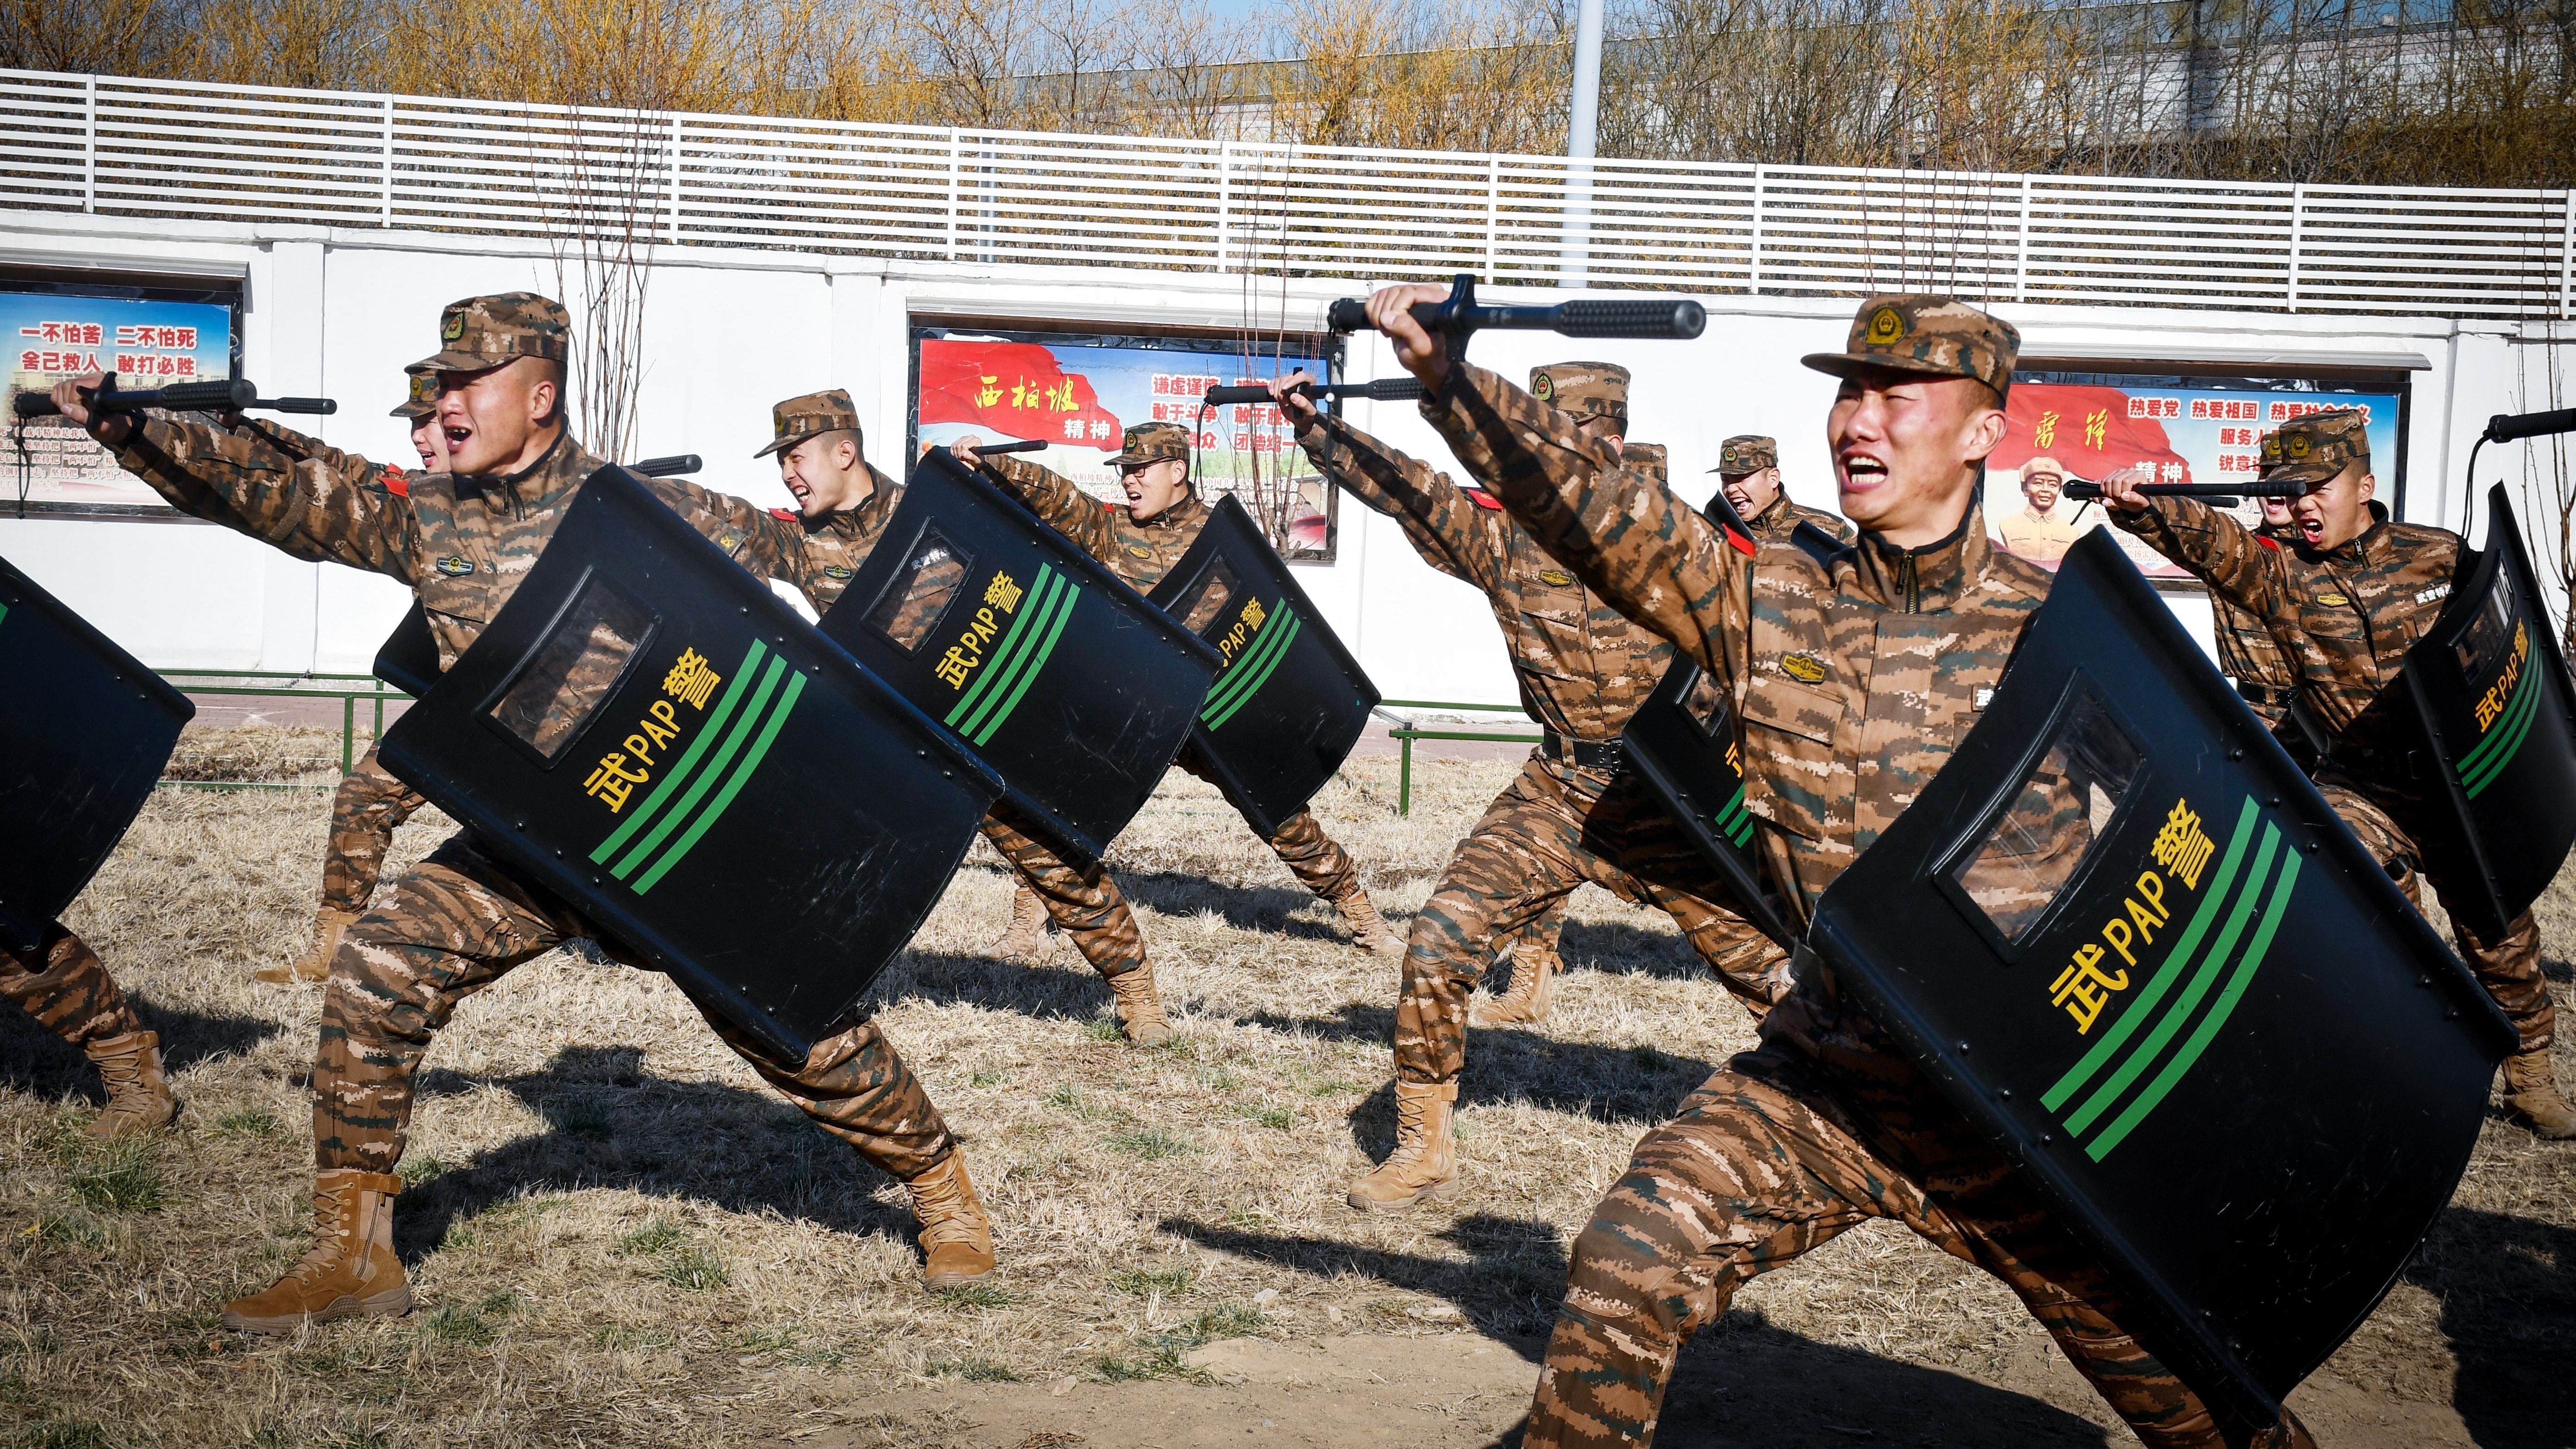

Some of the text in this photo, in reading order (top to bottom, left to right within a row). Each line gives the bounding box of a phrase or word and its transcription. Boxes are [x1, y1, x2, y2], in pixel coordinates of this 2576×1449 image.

[22, 323, 194, 347] 一不怕苦 二不怕死
[22, 351, 194, 375] 舍己救人 敢打必胜
[974, 375, 1080, 414] 西柏坡
[1152, 403, 1217, 423] 敢于斗争
[2130, 399, 2179, 417] 热爱党
[2192, 401, 2257, 420] 热爱祖国
[1064, 419, 1110, 440] 精神
[2034, 409, 2108, 451] 雷锋
[2220, 428, 2280, 446] 服务人
[2135, 461, 2183, 483] 精神
[1219, 596, 1266, 667] PAP警
